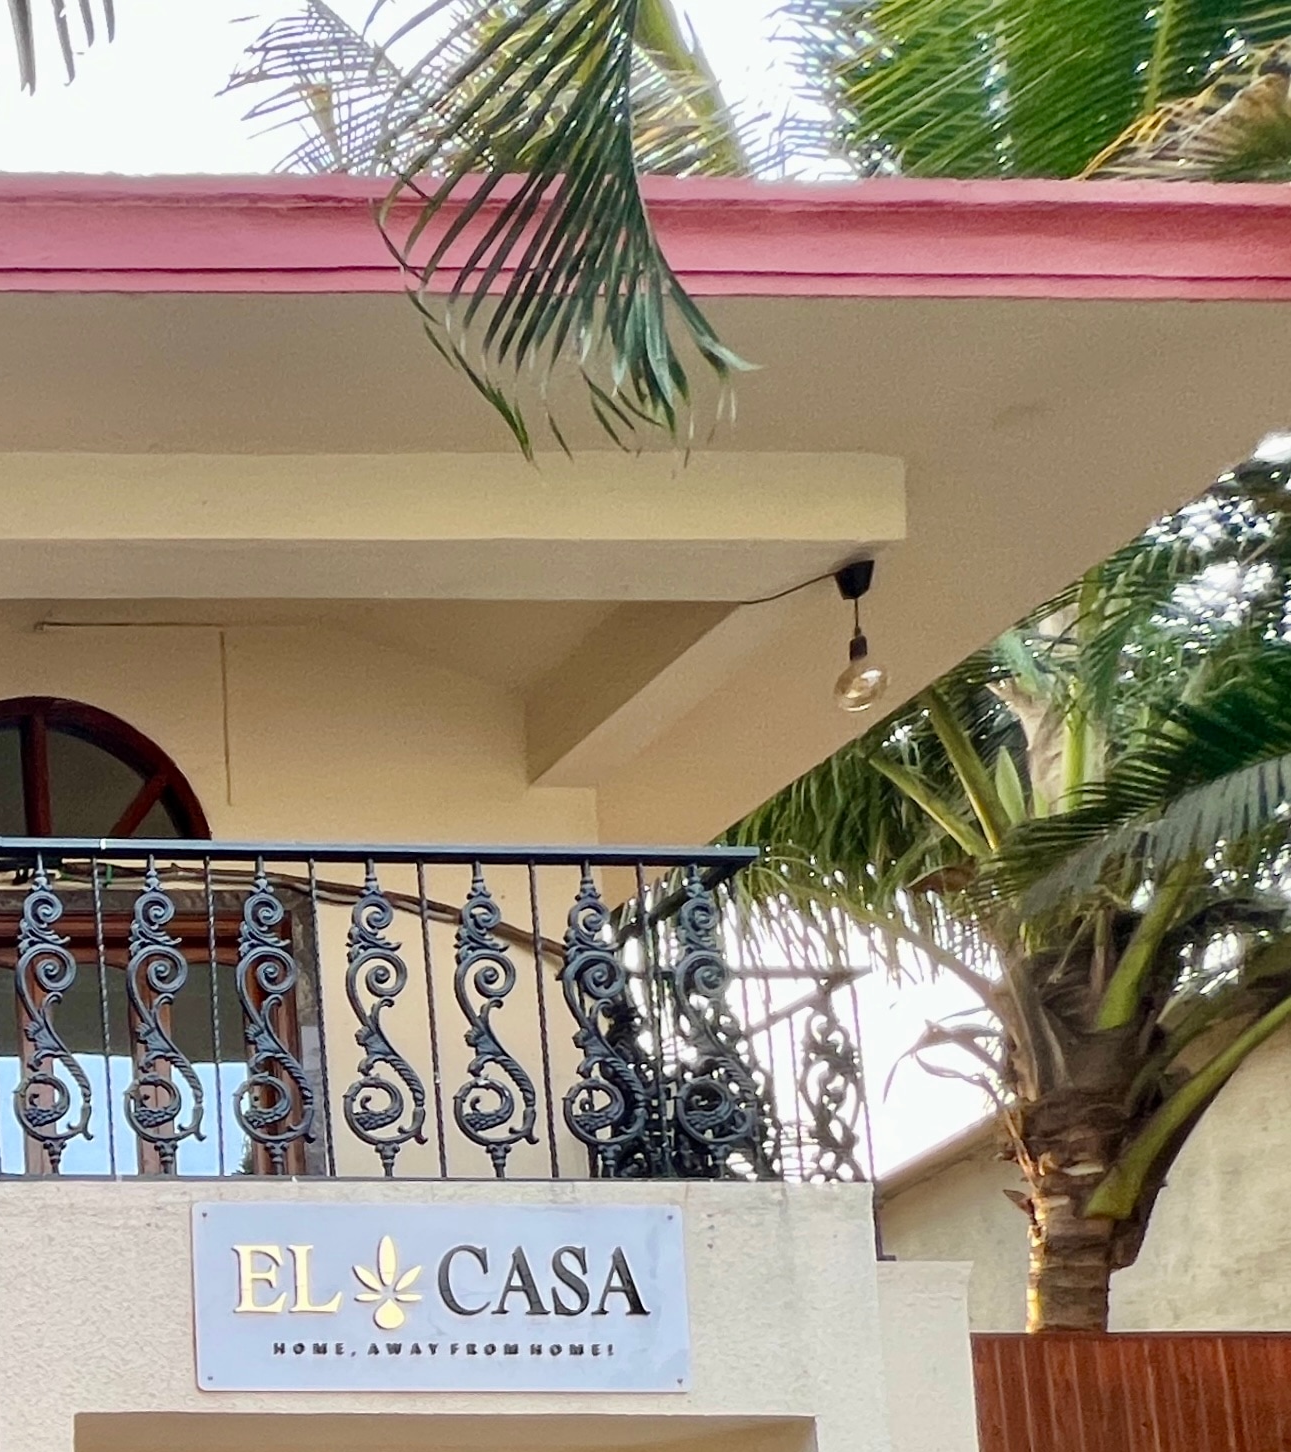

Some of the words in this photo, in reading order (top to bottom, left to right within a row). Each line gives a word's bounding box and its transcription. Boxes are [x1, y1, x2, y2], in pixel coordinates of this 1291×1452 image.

[231, 1244, 343, 1314] EL
[436, 1244, 652, 1317] CASA
[272, 1342, 357, 1358] HOME,
[367, 1342, 439, 1357] AWAY
[450, 1342, 519, 1357] FROM
[530, 1342, 615, 1357] HOME!
